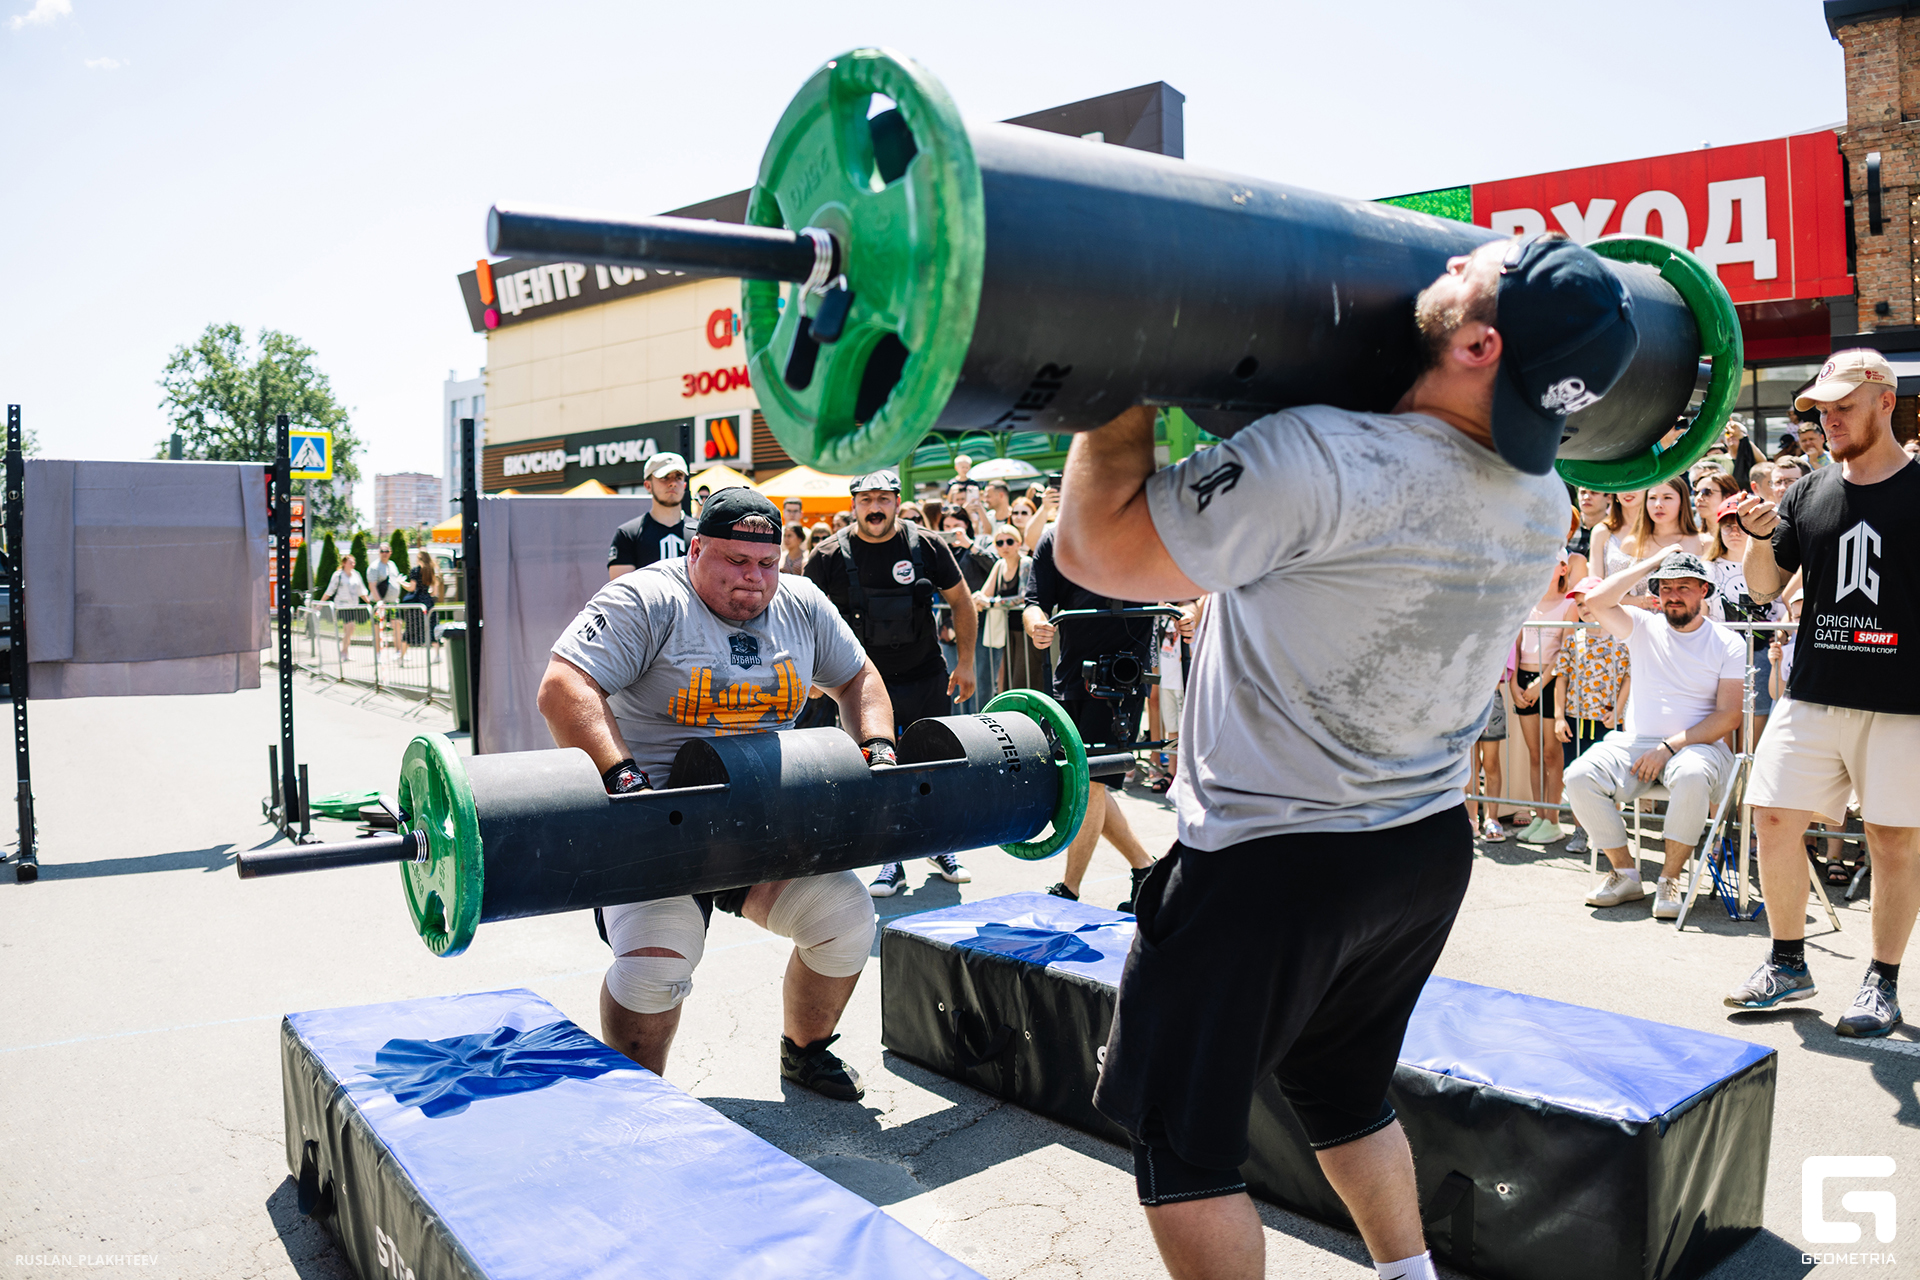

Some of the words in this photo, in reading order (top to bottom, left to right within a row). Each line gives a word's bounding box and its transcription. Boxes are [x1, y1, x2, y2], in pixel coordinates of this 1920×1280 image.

[495, 262, 588, 316] ЦЕНТР
[596, 437, 658, 466] ТОЧКА
[1816, 614, 1883, 630] ORIGINAL
[1814, 628, 1850, 643] GATE
[1857, 632, 1894, 644] SPORT
[1813, 642, 1847, 651] ОТКРЫВАЕМ
[1847, 645, 1871, 653] ВОРОТА
[1876, 647, 1898, 655] СПОРТ
[731, 653, 761, 665] КУБАНЬ
